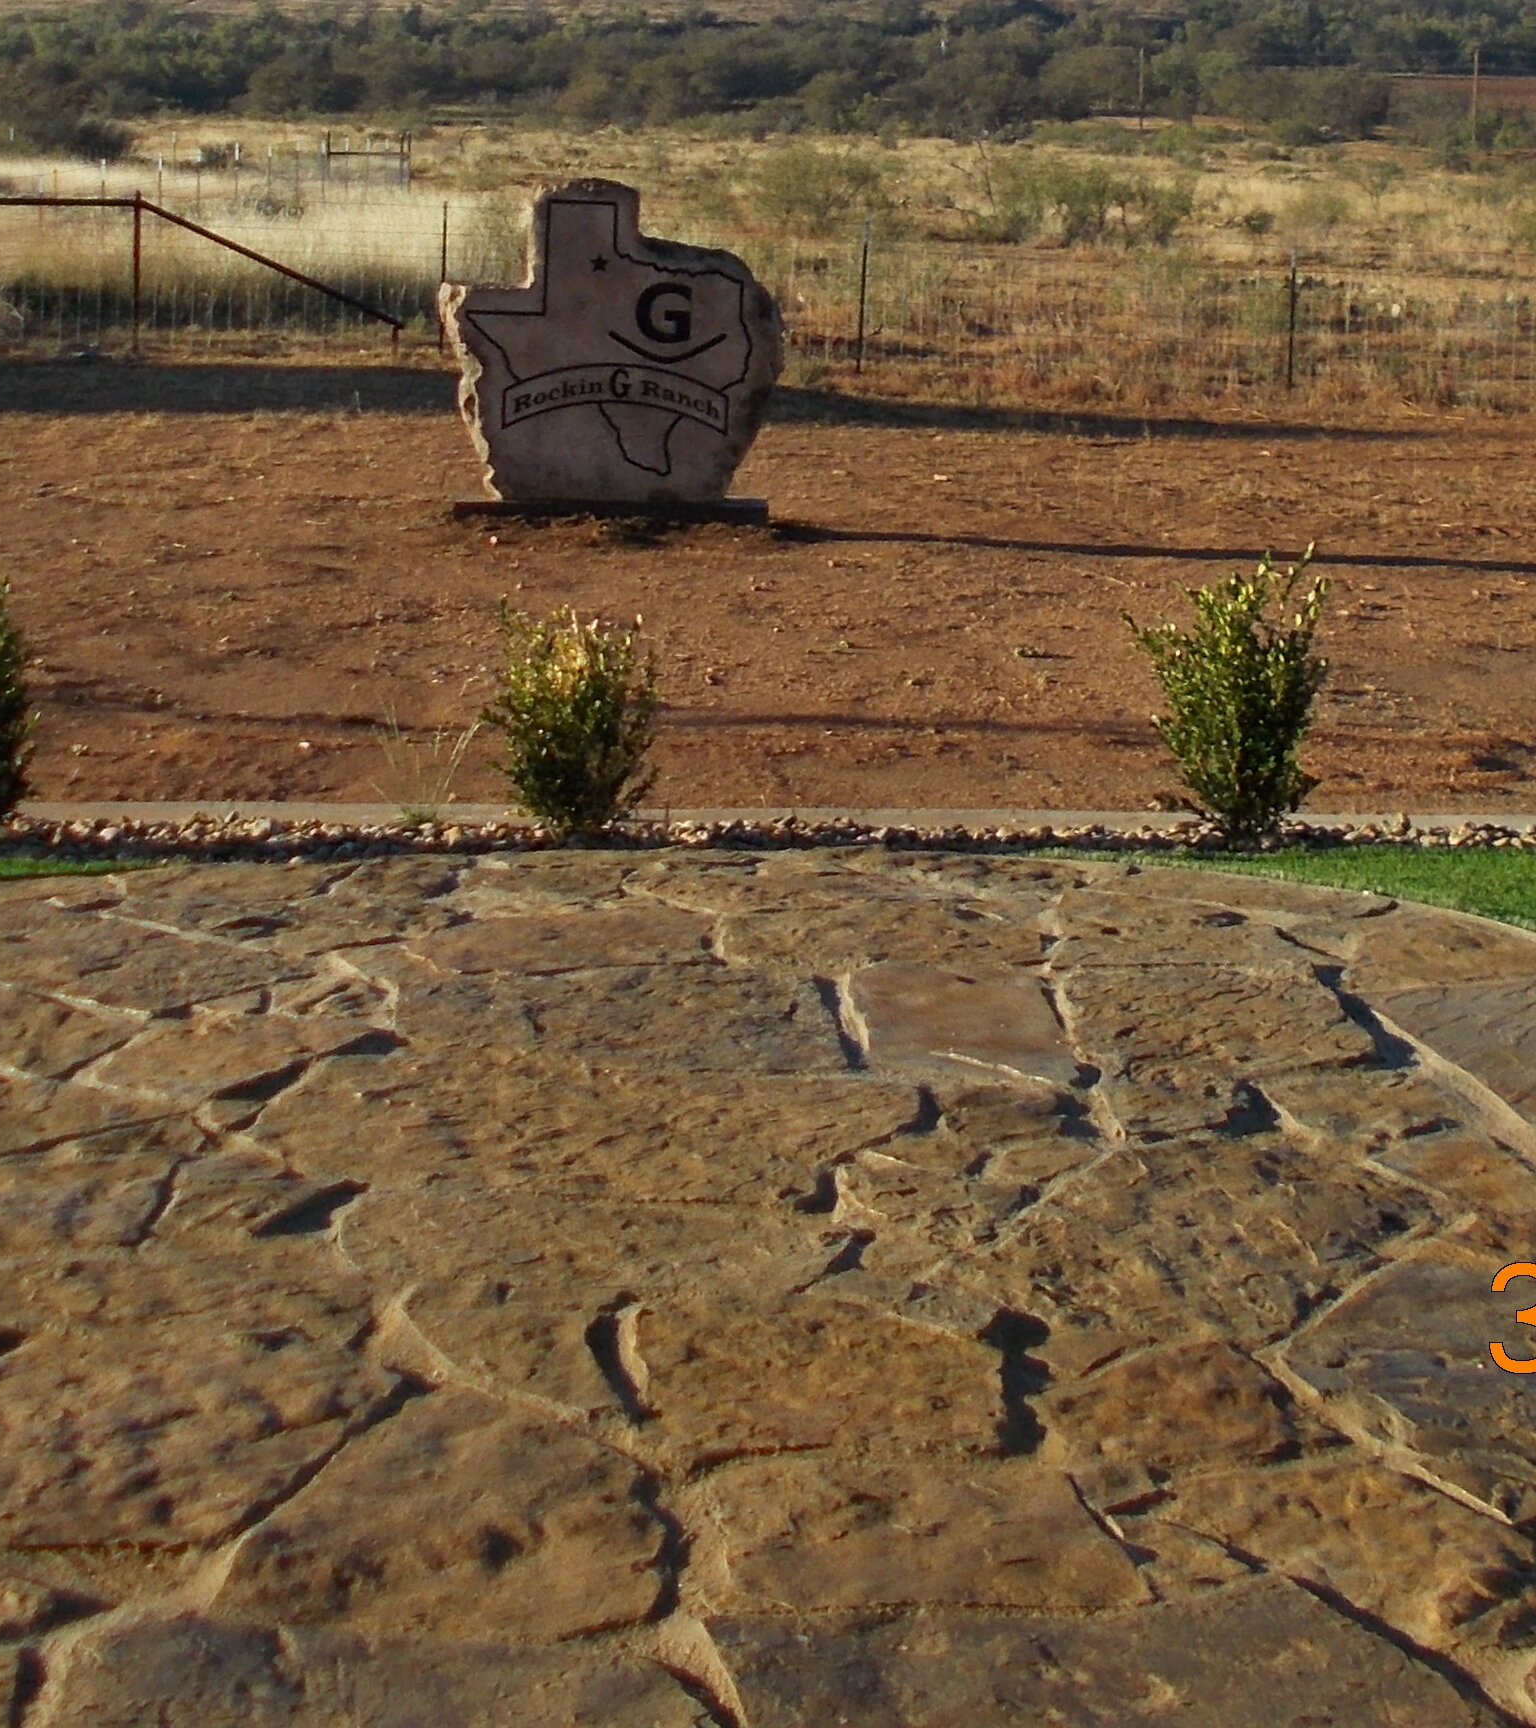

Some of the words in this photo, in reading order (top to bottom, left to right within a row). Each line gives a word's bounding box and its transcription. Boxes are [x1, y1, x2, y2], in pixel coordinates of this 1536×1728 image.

[635, 282, 693, 343] G
[513, 379, 602, 413] Rockin
[609, 369, 631, 399] G
[641, 379, 720, 420] Ranch
